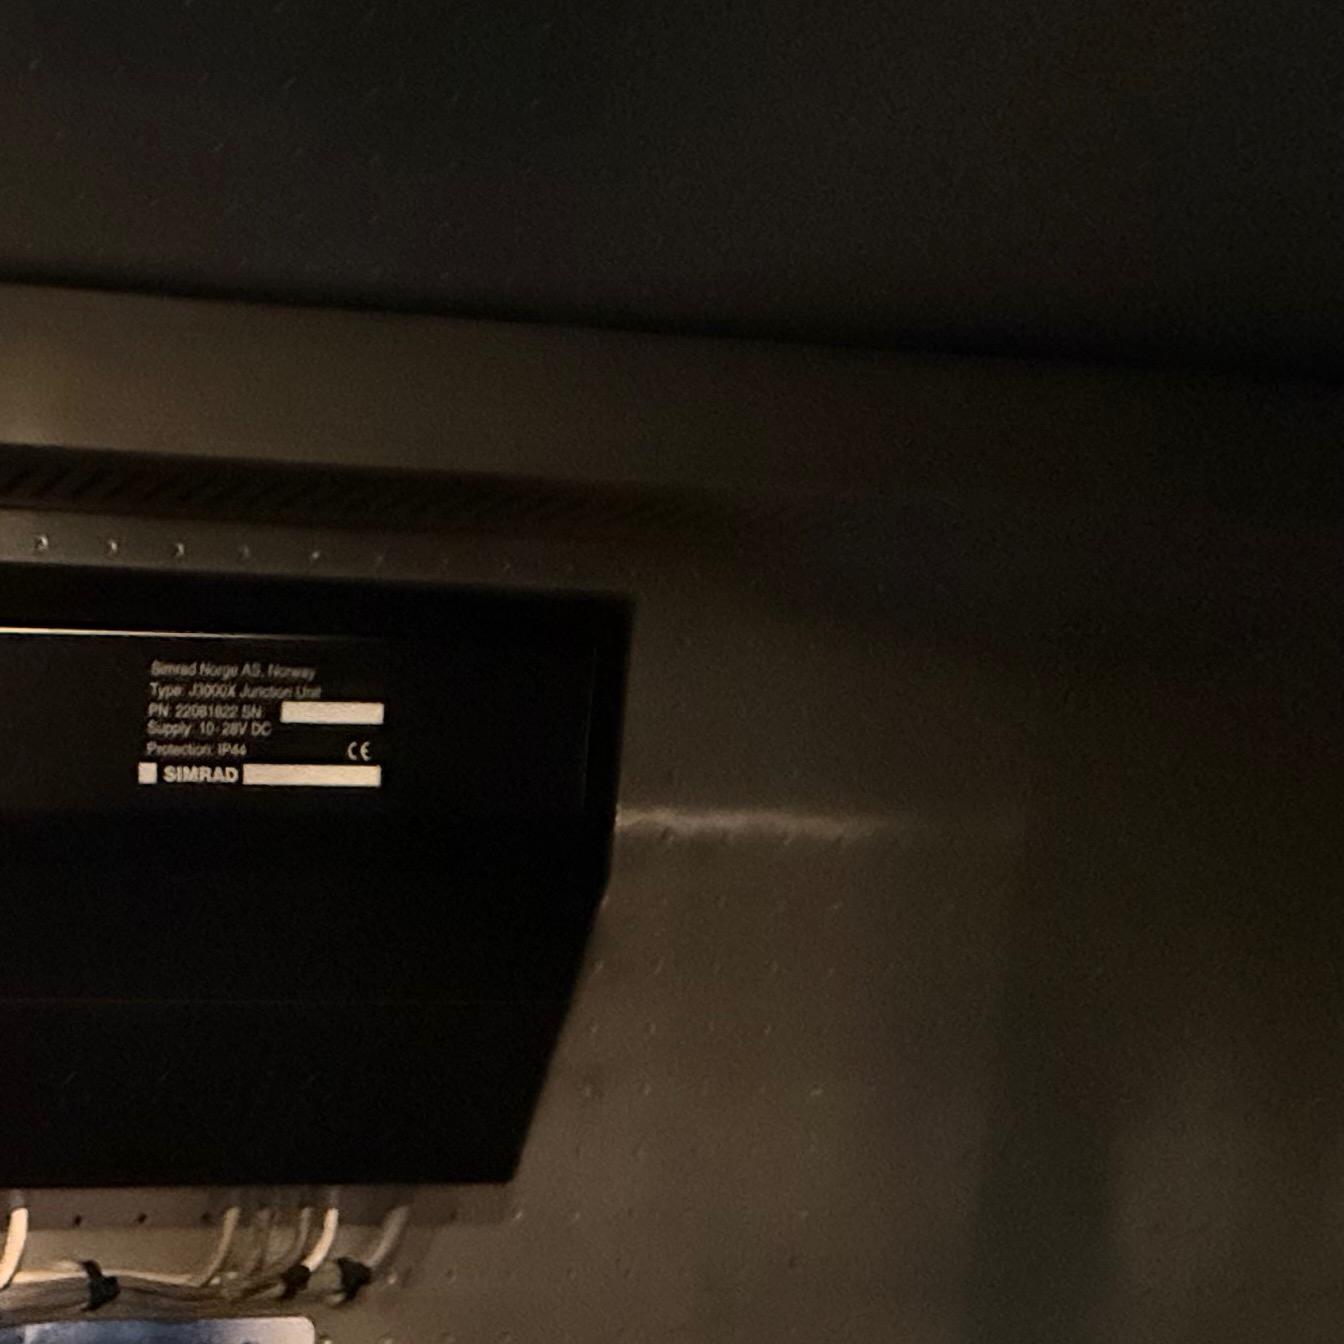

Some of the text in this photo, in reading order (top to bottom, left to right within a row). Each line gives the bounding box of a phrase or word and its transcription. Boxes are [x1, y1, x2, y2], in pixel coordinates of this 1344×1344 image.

[150, 660, 198, 677] Simrad
[251, 721, 273, 737] DC
[163, 766, 240, 784] SIMRAD
